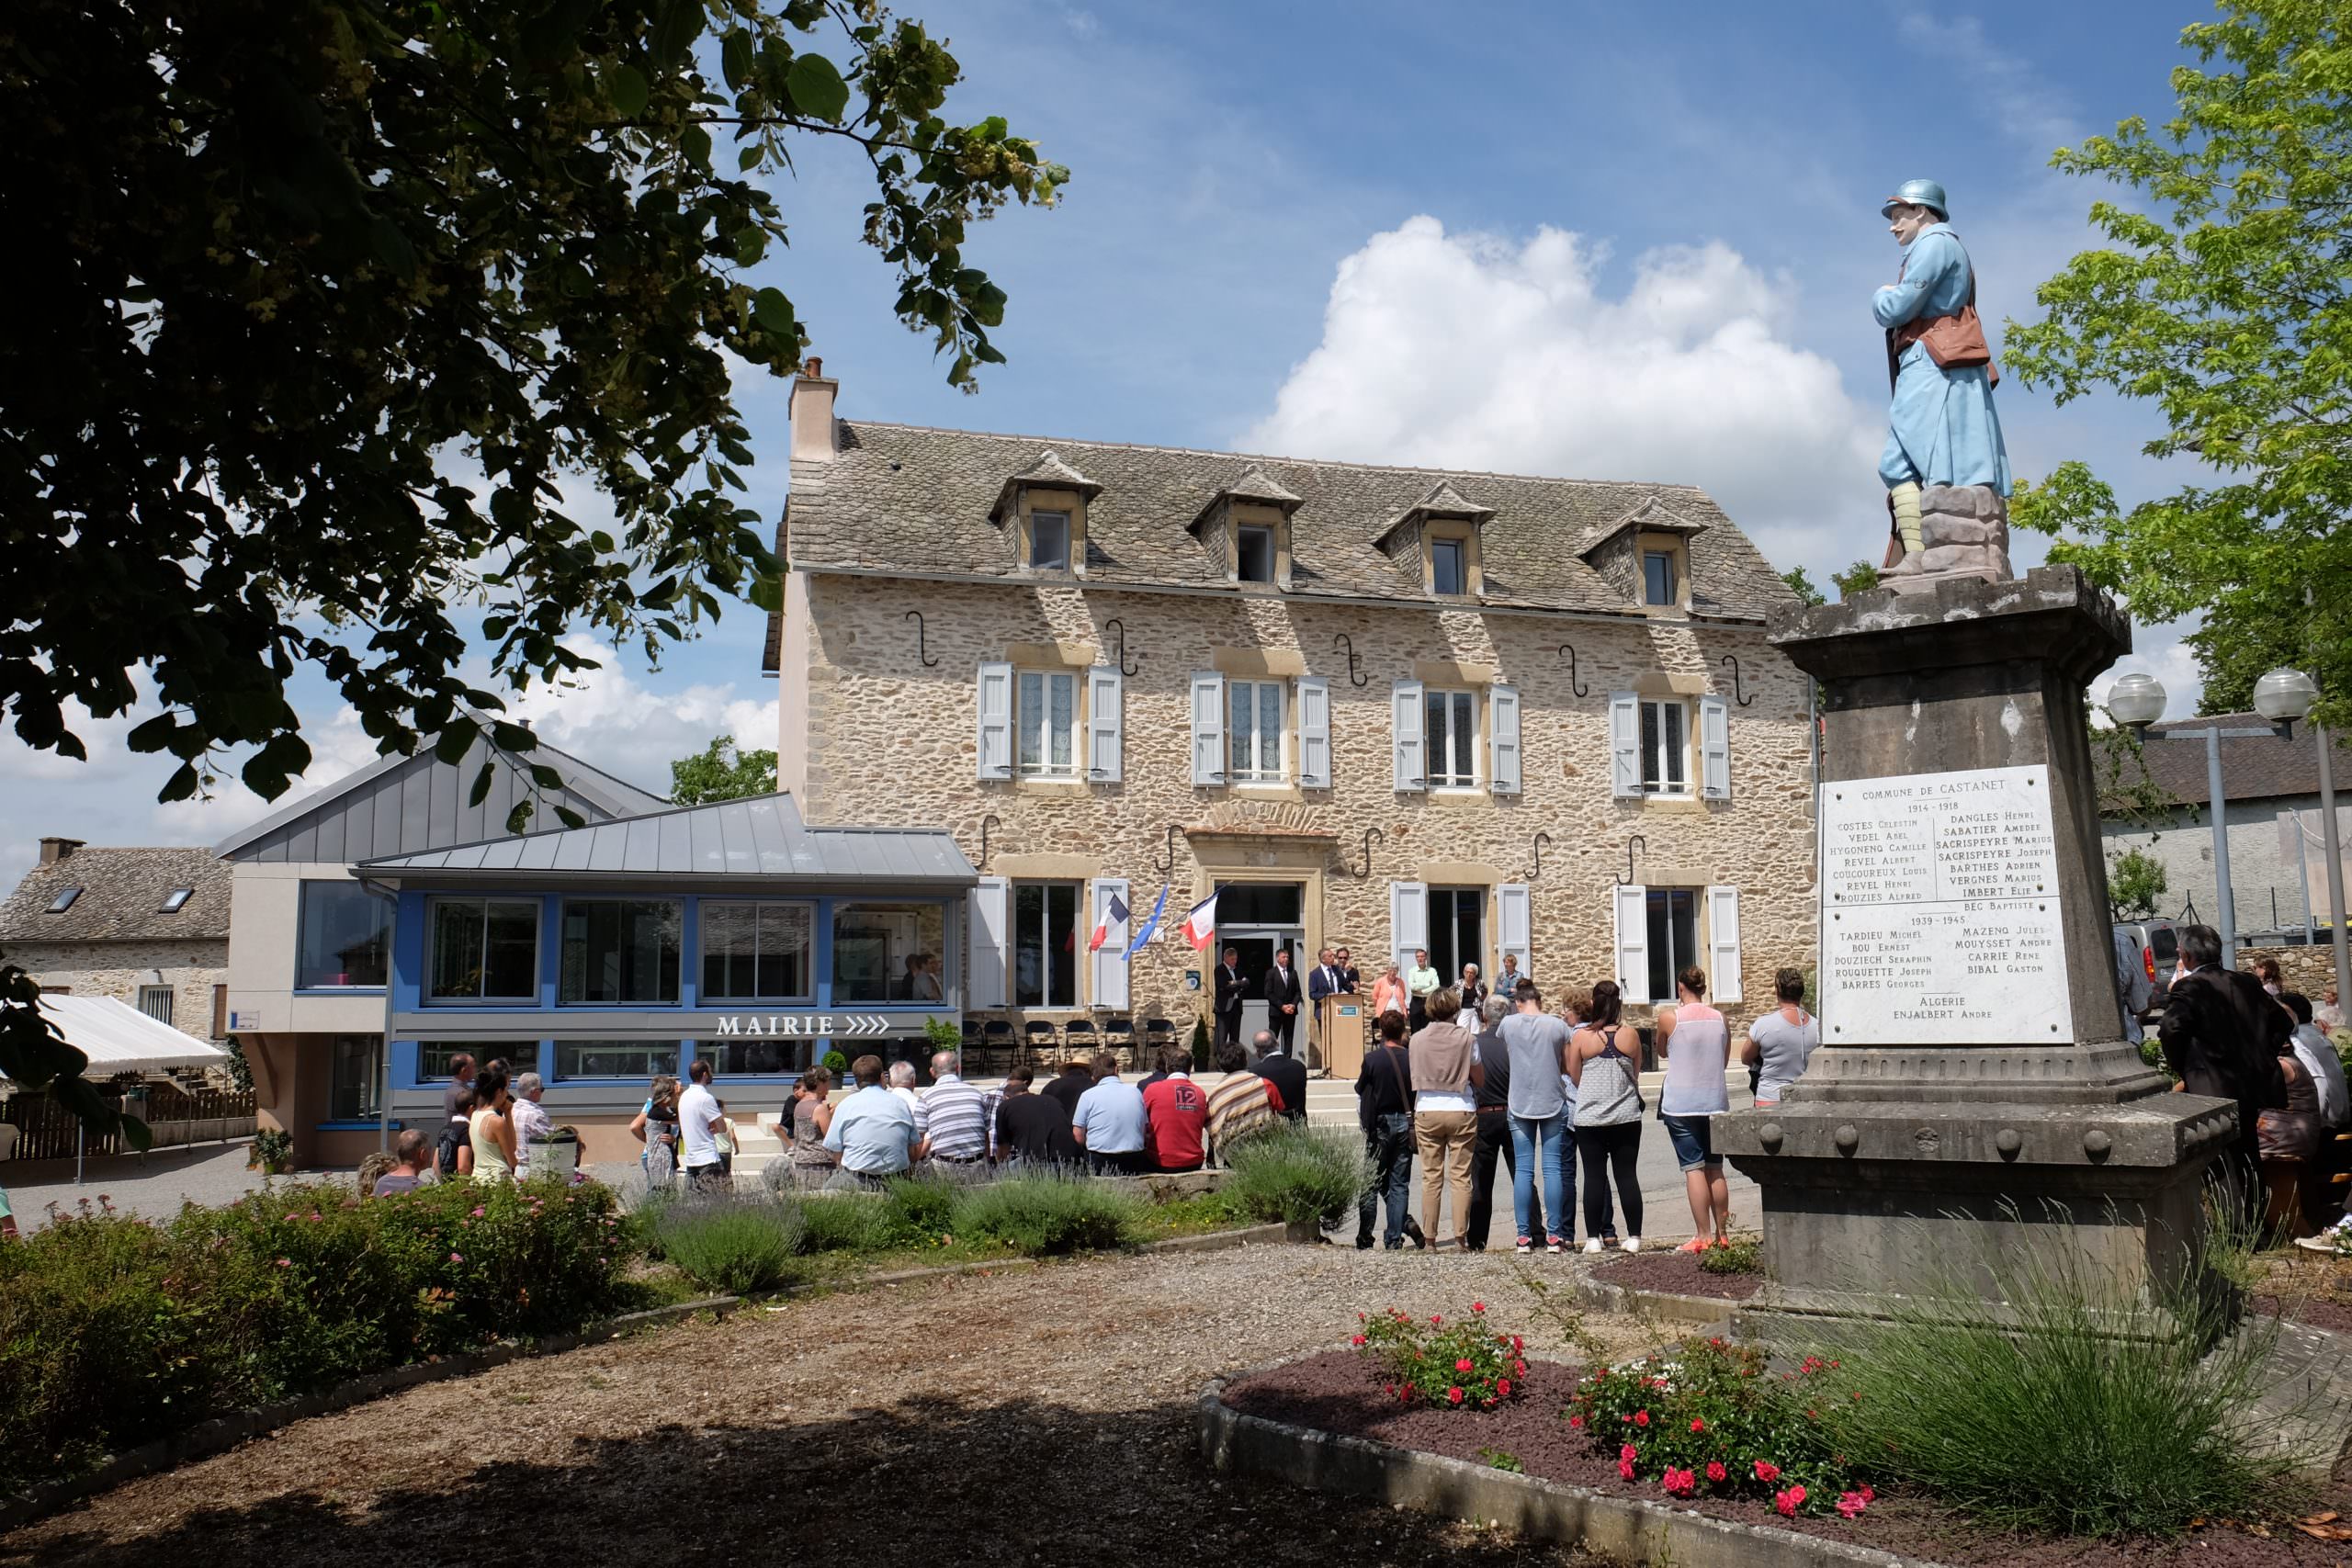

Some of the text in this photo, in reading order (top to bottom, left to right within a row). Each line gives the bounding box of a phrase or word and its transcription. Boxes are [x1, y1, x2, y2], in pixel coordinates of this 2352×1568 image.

[1862, 780, 2006, 800] COMMUNE DE CASTANET
[1908, 805, 1928, 813] 1914
[1951, 813, 1998, 823] DANGLES
[1838, 822, 1873, 831] COSTES
[1943, 826, 1997, 836] SABATIER
[1849, 833, 1880, 842] VEDEL
[1936, 837, 2007, 849] SACRISPEYRE
[1830, 845, 1883, 856] HYGONENQ
[1939, 850, 2011, 861] SACRISPEYRE
[1845, 858, 1876, 867] REVEL
[1951, 863, 1999, 873] BARTHES
[1833, 868, 1895, 879] COUCOUREUX
[1950, 875, 1998, 886] VERGNES
[1847, 882, 1879, 891] REVEL
[1963, 888, 2004, 897] IMBERT
[1841, 894, 1883, 903] ROUZIES
[1912, 918, 1933, 926] 1939
[1943, 916, 1965, 925] 1945
[1840, 931, 1883, 942] TARDIEU
[1962, 927, 2009, 937] MAZENQ
[1852, 943, 1870, 953] BOU
[1955, 940, 2011, 949] MOUYSSET
[1835, 956, 1882, 965] DOUZIECH
[1968, 953, 2008, 961] CARRIE
[1836, 968, 1894, 977] ROUQUETTE
[1968, 965, 1999, 974] BIBAL
[1842, 981, 1881, 989] BARRES
[1920, 997, 1965, 1007] ALGERIE
[1894, 1010, 1953, 1020] ENJALBERT
[716, 1016, 834, 1036] MAIRIE
[1177, 1090, 1196, 1104] 12
